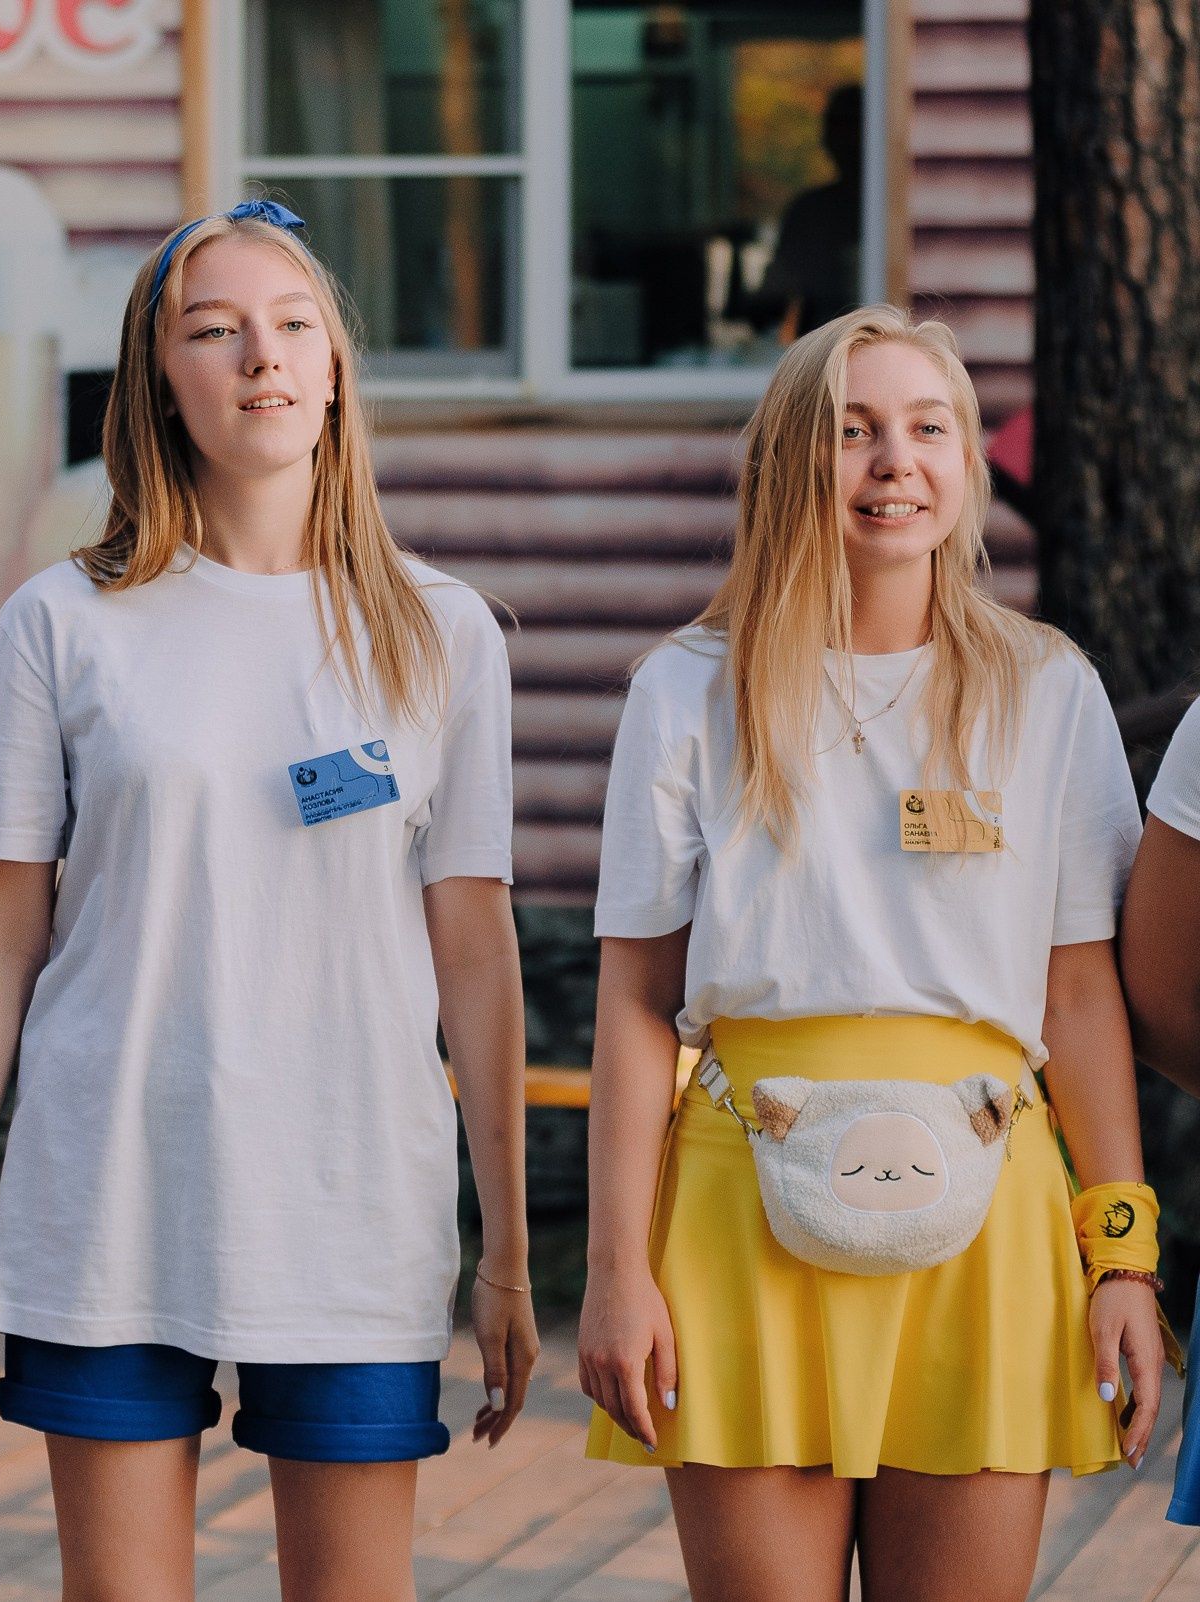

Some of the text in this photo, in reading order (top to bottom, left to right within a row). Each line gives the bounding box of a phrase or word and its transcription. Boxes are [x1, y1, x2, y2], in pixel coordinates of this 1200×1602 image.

[385, 774, 397, 799] ОТРЯД
[301, 786, 344, 804] АНАСТАСИЯ
[303, 797, 336, 812] КОЗЛОВА
[904, 822, 928, 830] ОЛЬГА
